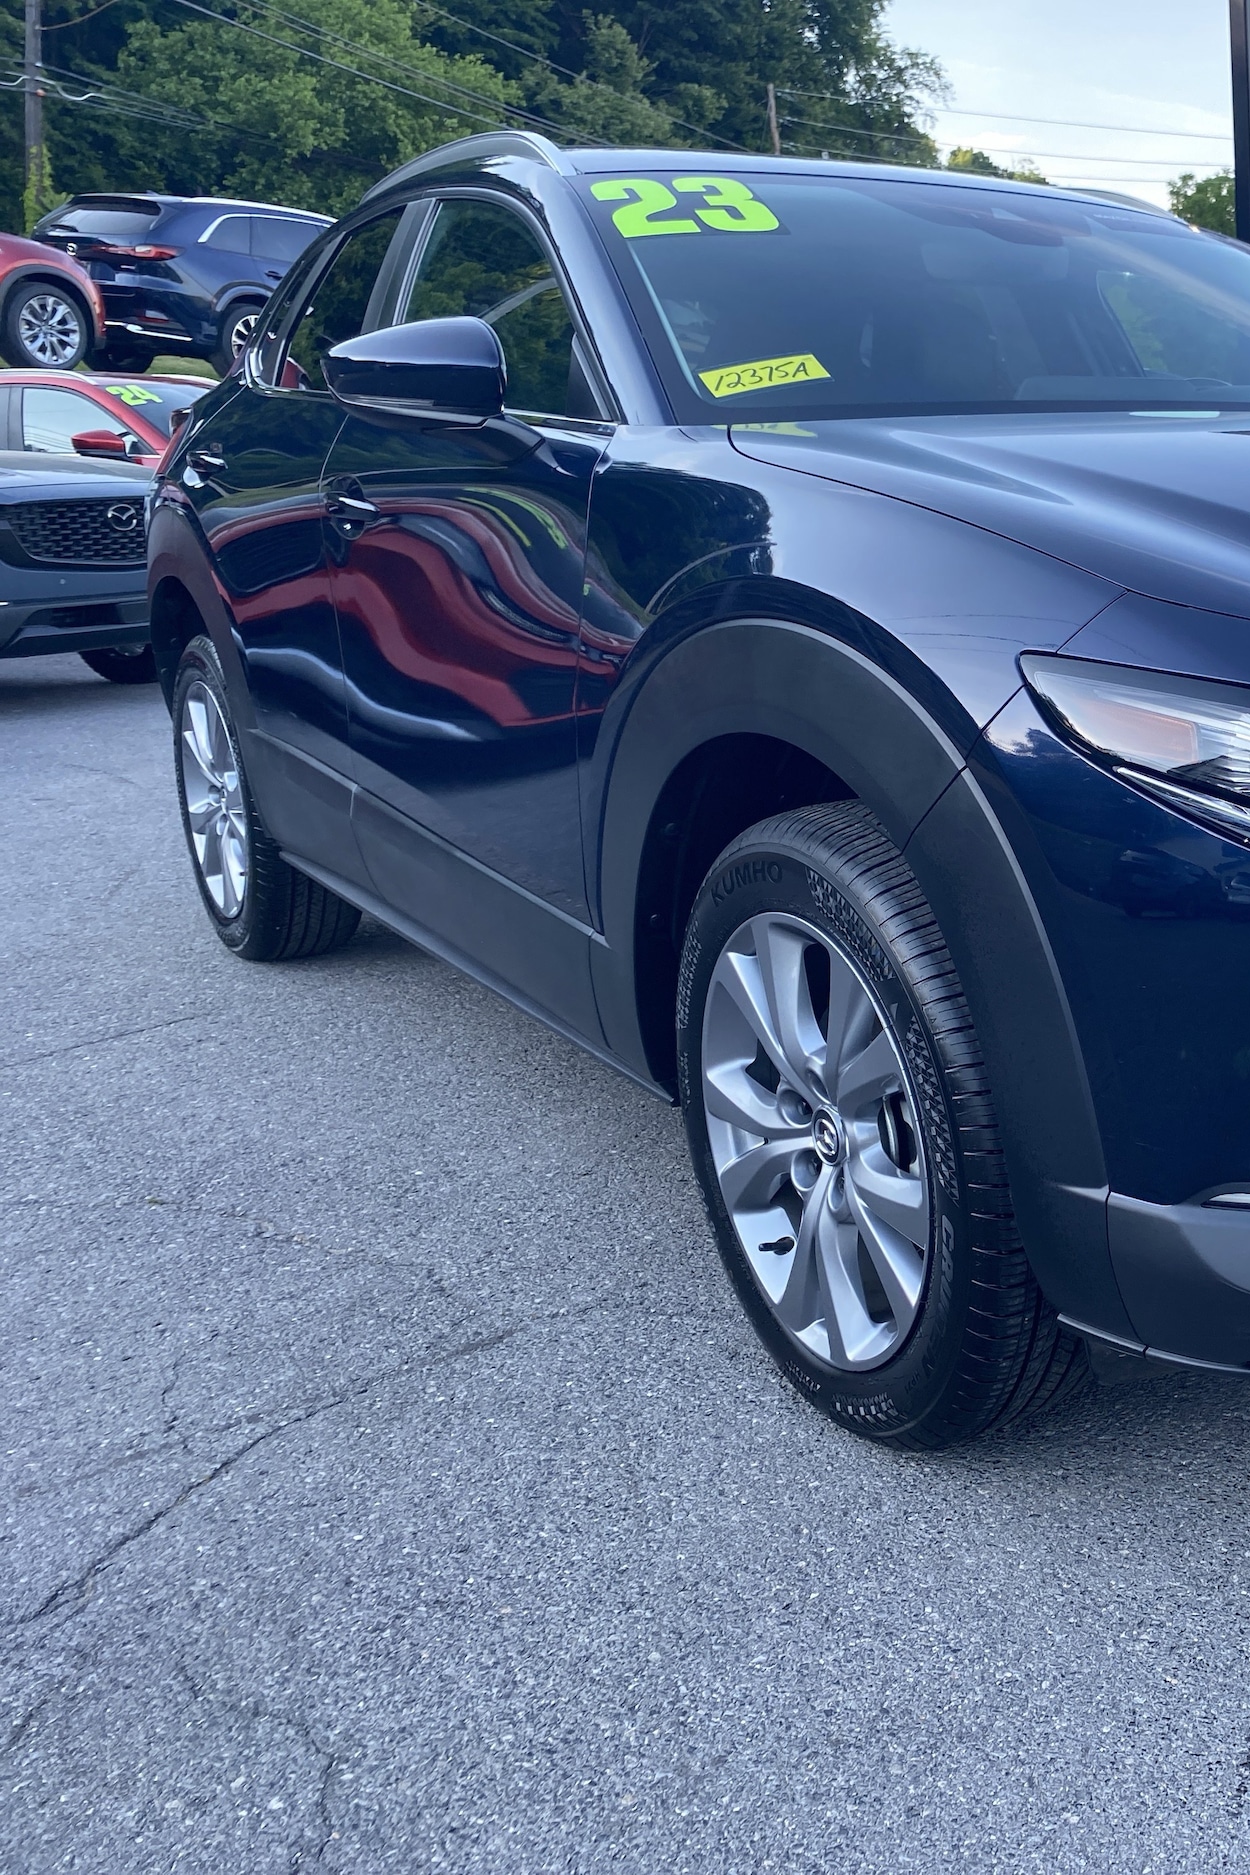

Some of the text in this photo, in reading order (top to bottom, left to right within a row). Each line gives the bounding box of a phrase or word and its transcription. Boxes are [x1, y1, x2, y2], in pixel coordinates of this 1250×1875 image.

[590, 176, 780, 239] 23
[105, 384, 164, 406] 24
[714, 361, 811, 392] 12375A
[710, 860, 783, 908] KUMHO
